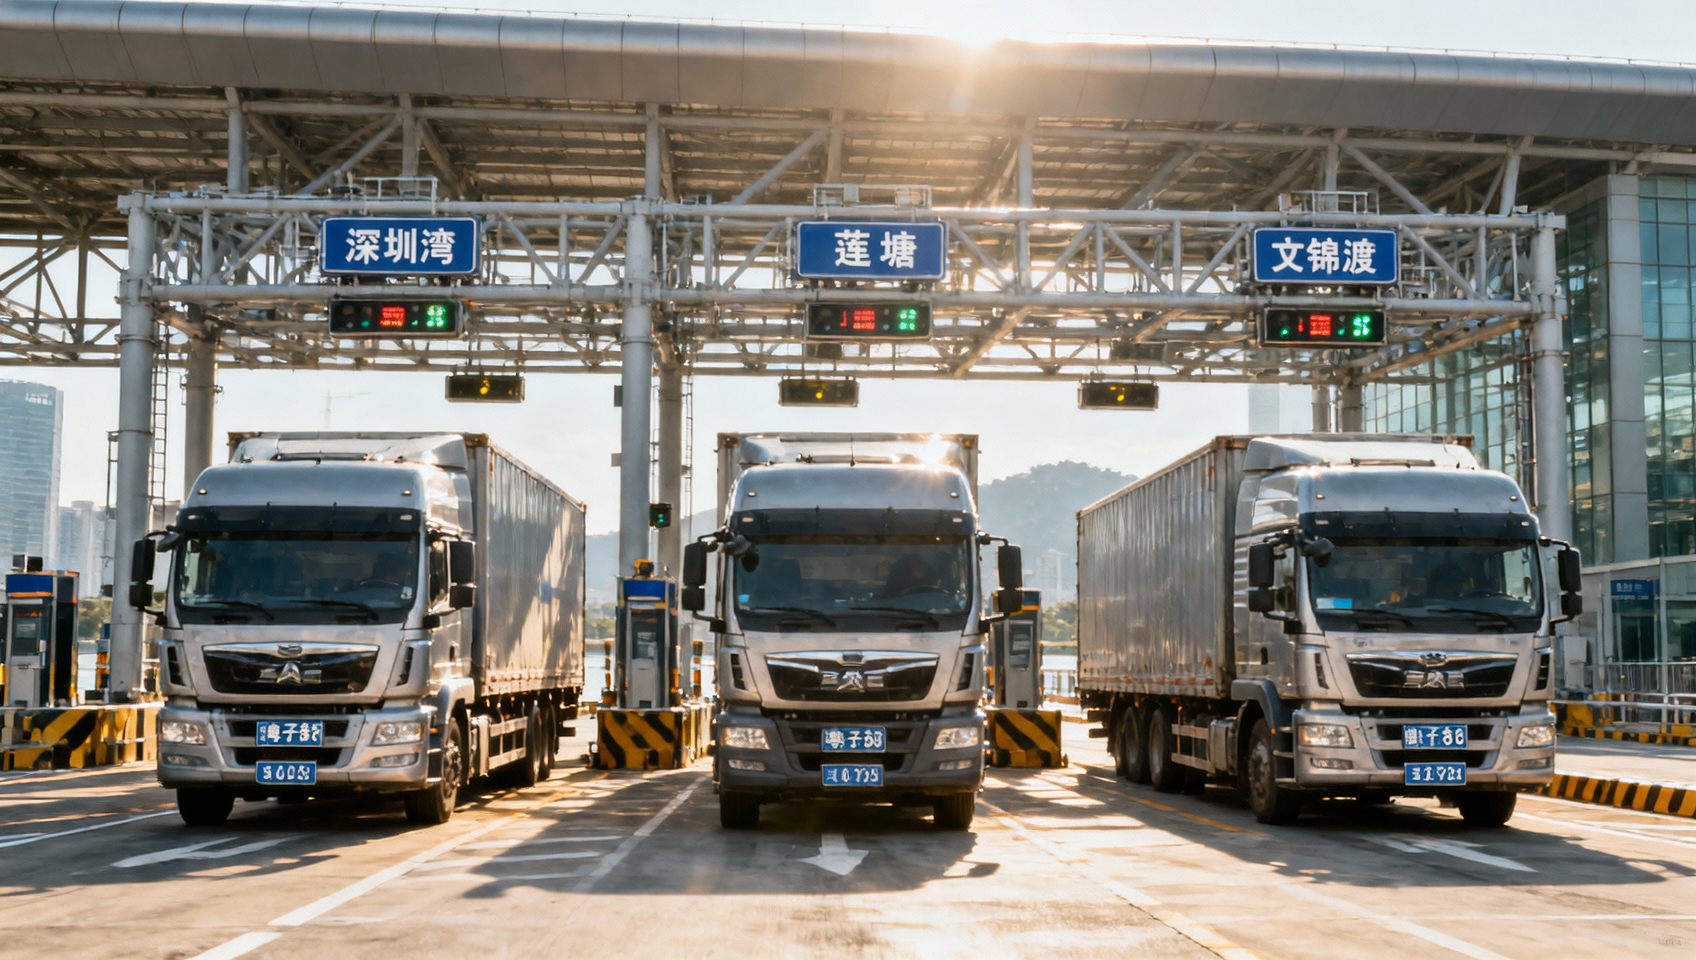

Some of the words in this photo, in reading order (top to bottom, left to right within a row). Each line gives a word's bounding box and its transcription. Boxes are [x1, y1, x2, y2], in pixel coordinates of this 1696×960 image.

[345, 227, 456, 266] 深圳湾
[834, 229, 918, 269] 莲塘
[1271, 236, 1377, 275] 文锦渡
